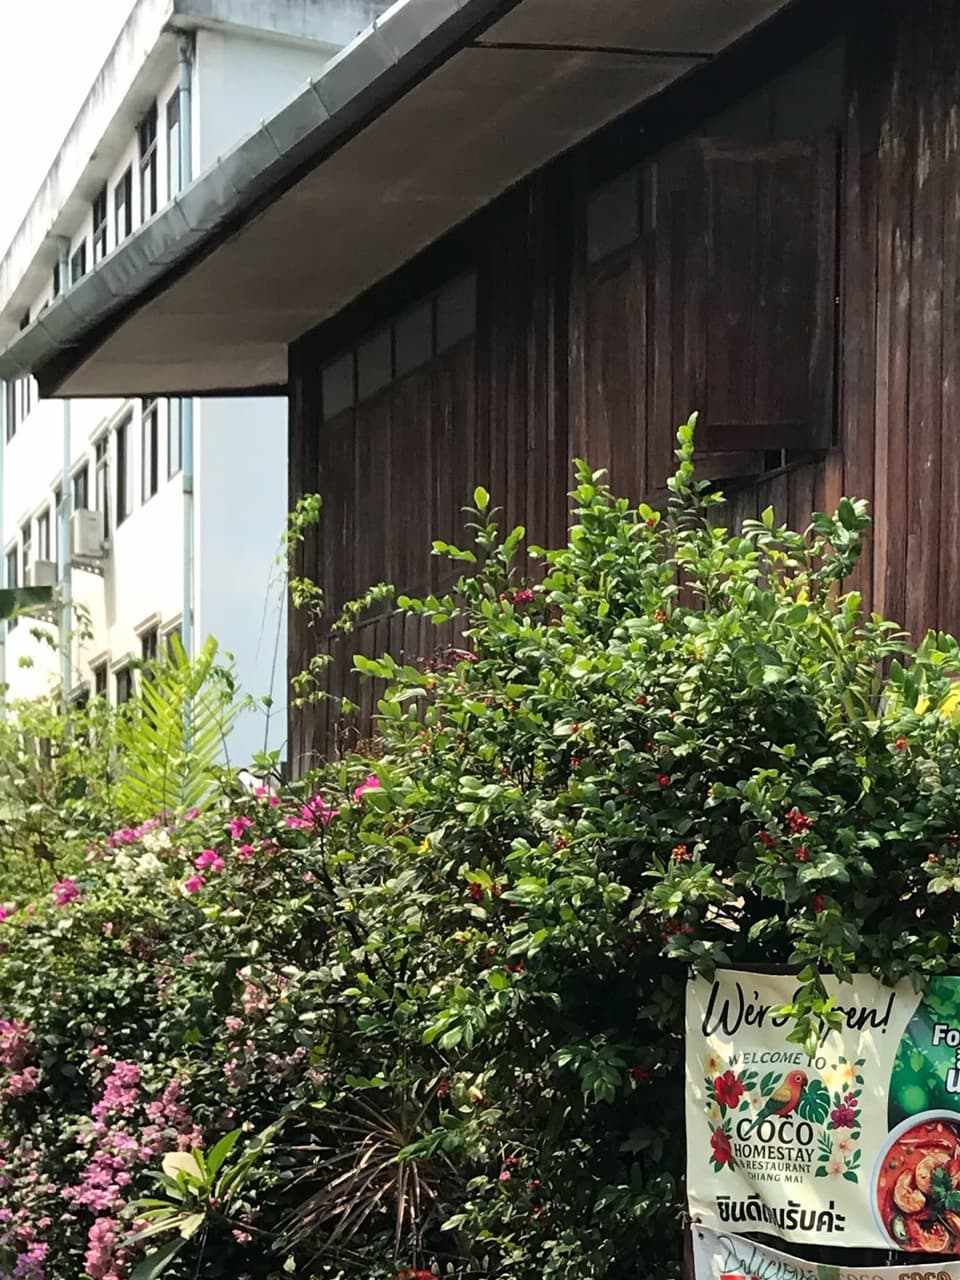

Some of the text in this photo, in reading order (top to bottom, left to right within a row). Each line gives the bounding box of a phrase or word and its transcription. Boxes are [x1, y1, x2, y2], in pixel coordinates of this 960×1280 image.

[728, 1052, 827, 1071] WELCOME TO
[736, 1117, 814, 1146] COCO
[734, 1143, 815, 1163] HOMESTAY
[745, 1160, 812, 1174] RESTAURANT
[784, 1174, 803, 1184] MAI
